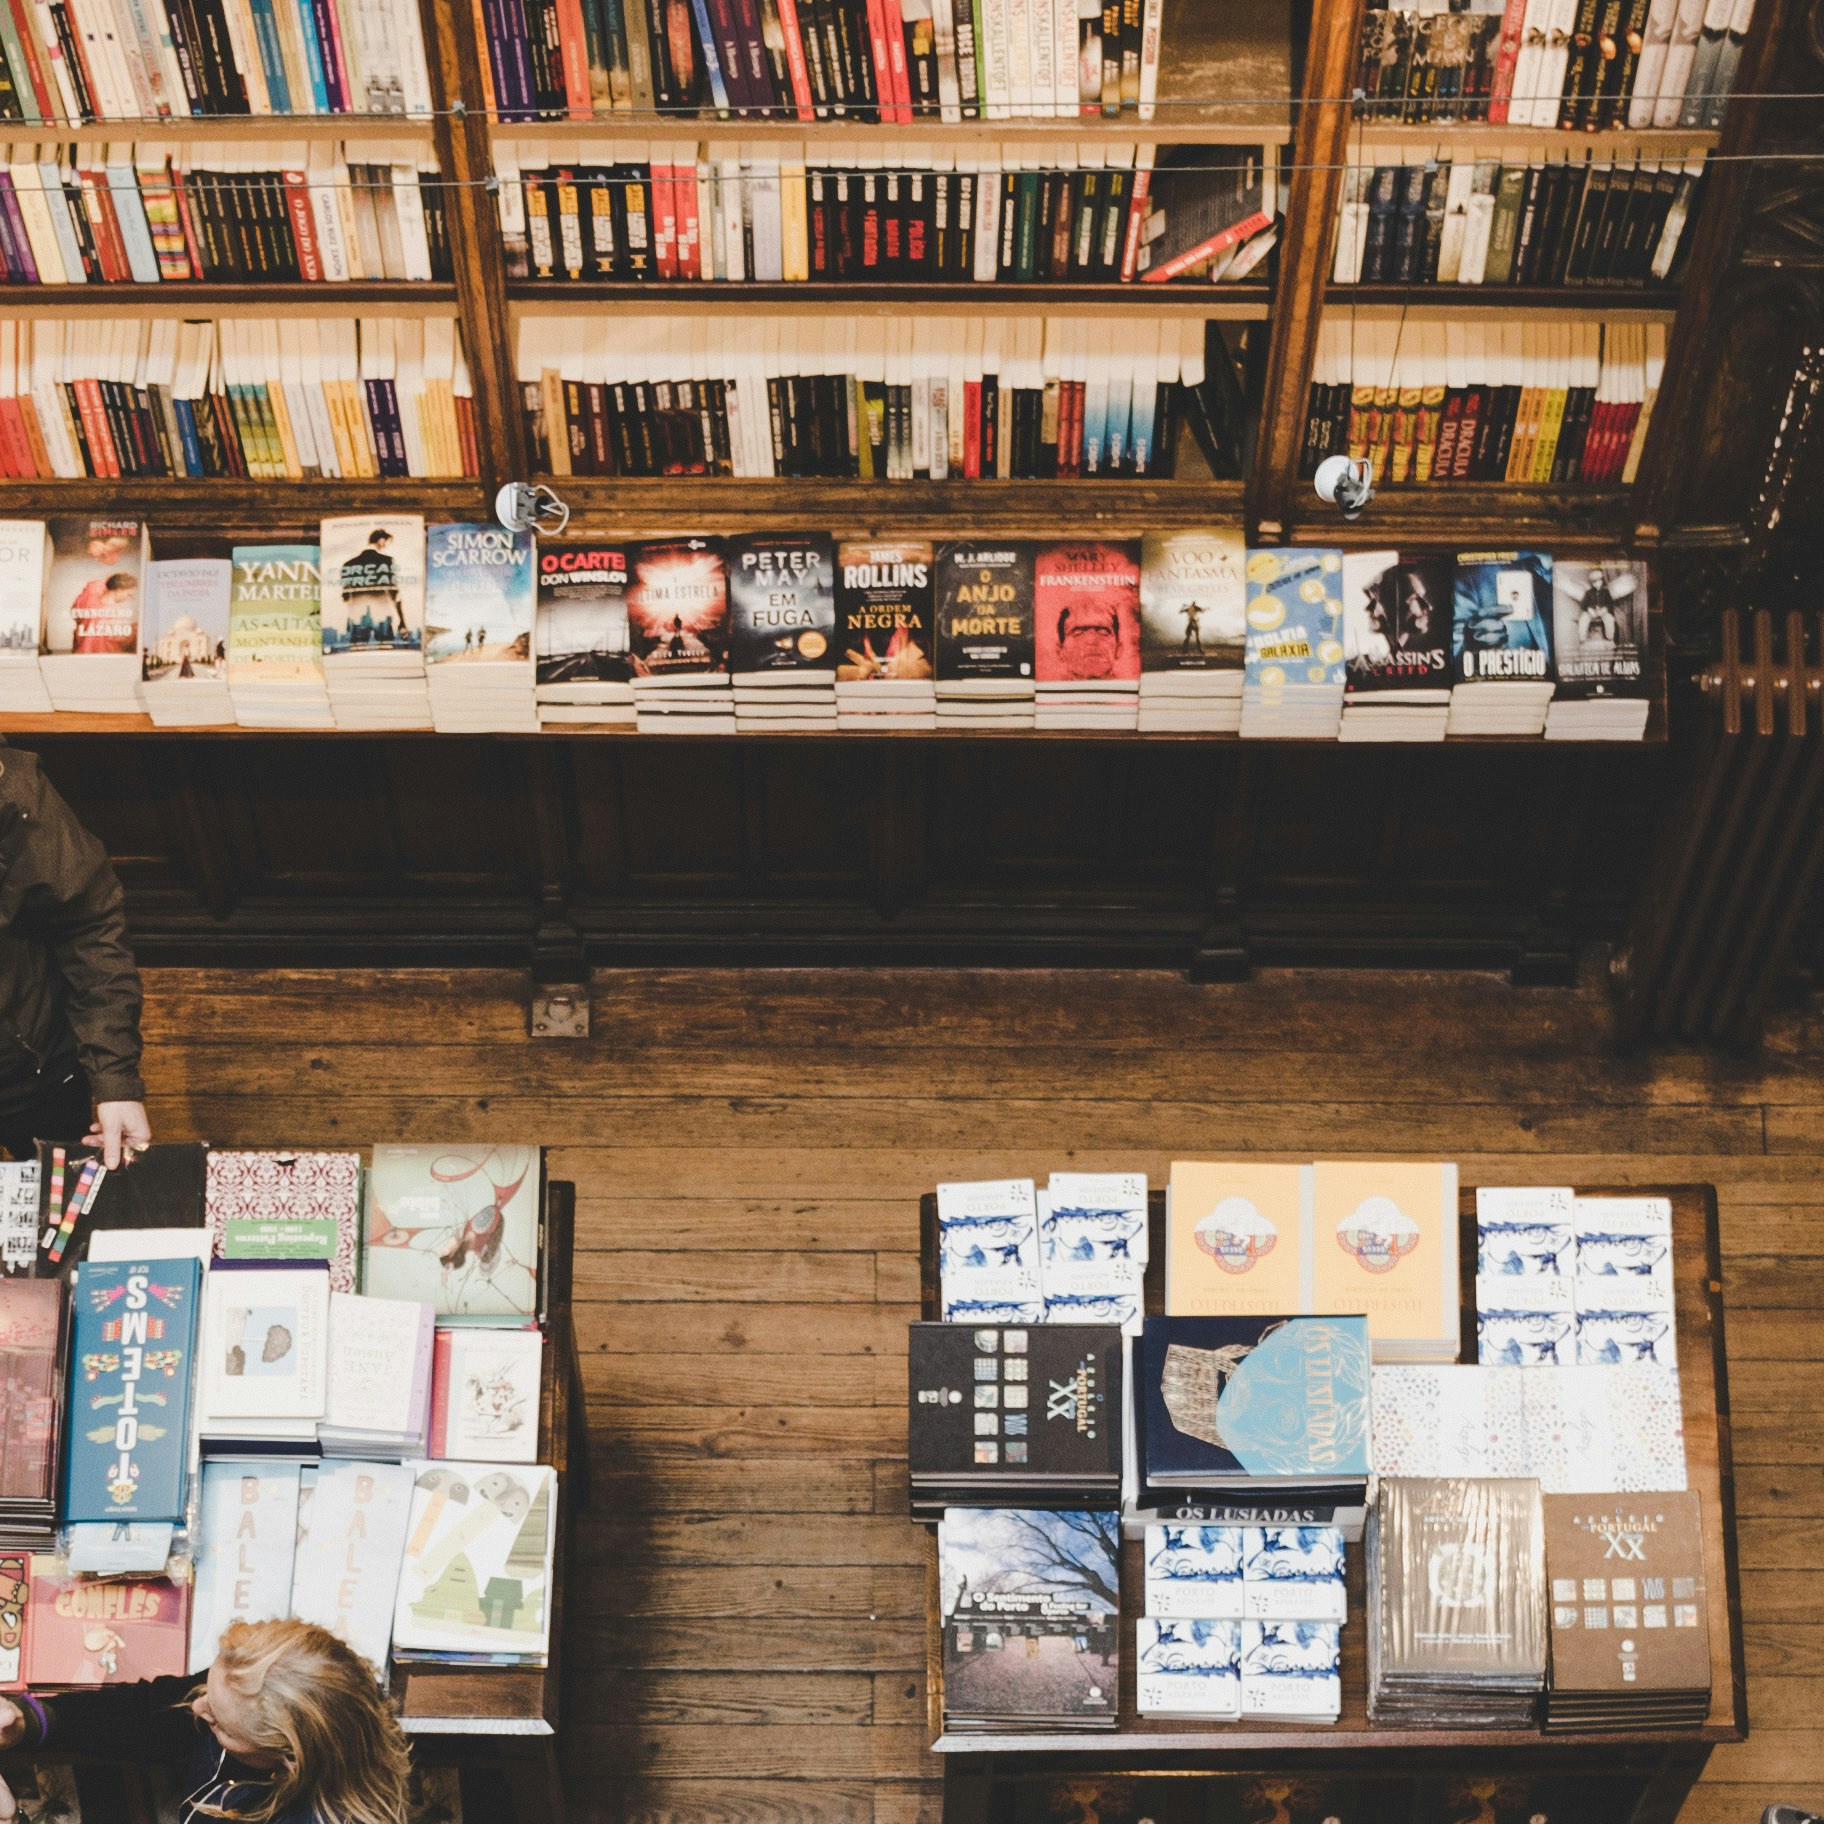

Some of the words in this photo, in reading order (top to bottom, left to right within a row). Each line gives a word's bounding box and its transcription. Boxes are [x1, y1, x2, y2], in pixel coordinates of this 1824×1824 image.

[447, 532, 514, 551] SIMON
[433, 549, 527, 568] SCARROW
[542, 555, 557, 573] O
[559, 551, 625, 571] CARTE
[742, 552, 821, 571] PETER
[1171, 551, 1214, 565] VOO
[238, 560, 322, 583] YANN
[756, 571, 808, 586] MAY
[844, 565, 928, 589] ROLLINS
[980, 570, 991, 582] O
[1148, 566, 1237, 581] FANTASMA
[542, 574, 569, 586] DON
[1039, 573, 1135, 587] FRANKENSTEIN
[769, 593, 797, 606] EM
[956, 585, 1016, 603] ANJO
[869, 604, 912, 613] ORDEM
[753, 610, 814, 626] FUGA
[847, 614, 923, 630] NEGRA
[78, 622, 133, 637] LÁZARO
[951, 618, 1021, 636] MORTE
[1463, 652, 1474, 676] O
[1479, 647, 1545, 676] PRESTÍGIO
[1304, 1325, 1333, 1353] OS
[113, 1275, 150, 1485] TOTEMS
[1076, 1368, 1089, 1433] PORTUGAL
[1176, 1507, 1204, 1521] OS
[1589, 1521, 1658, 1534] PORTUGAL
[1603, 1532, 1648, 1561] XX
[54, 1583, 162, 1621] GONFLÉS
[973, 1592, 985, 1603] O
[987, 1592, 1052, 1604] Sentimento
[997, 1603, 1029, 1613] Porto
